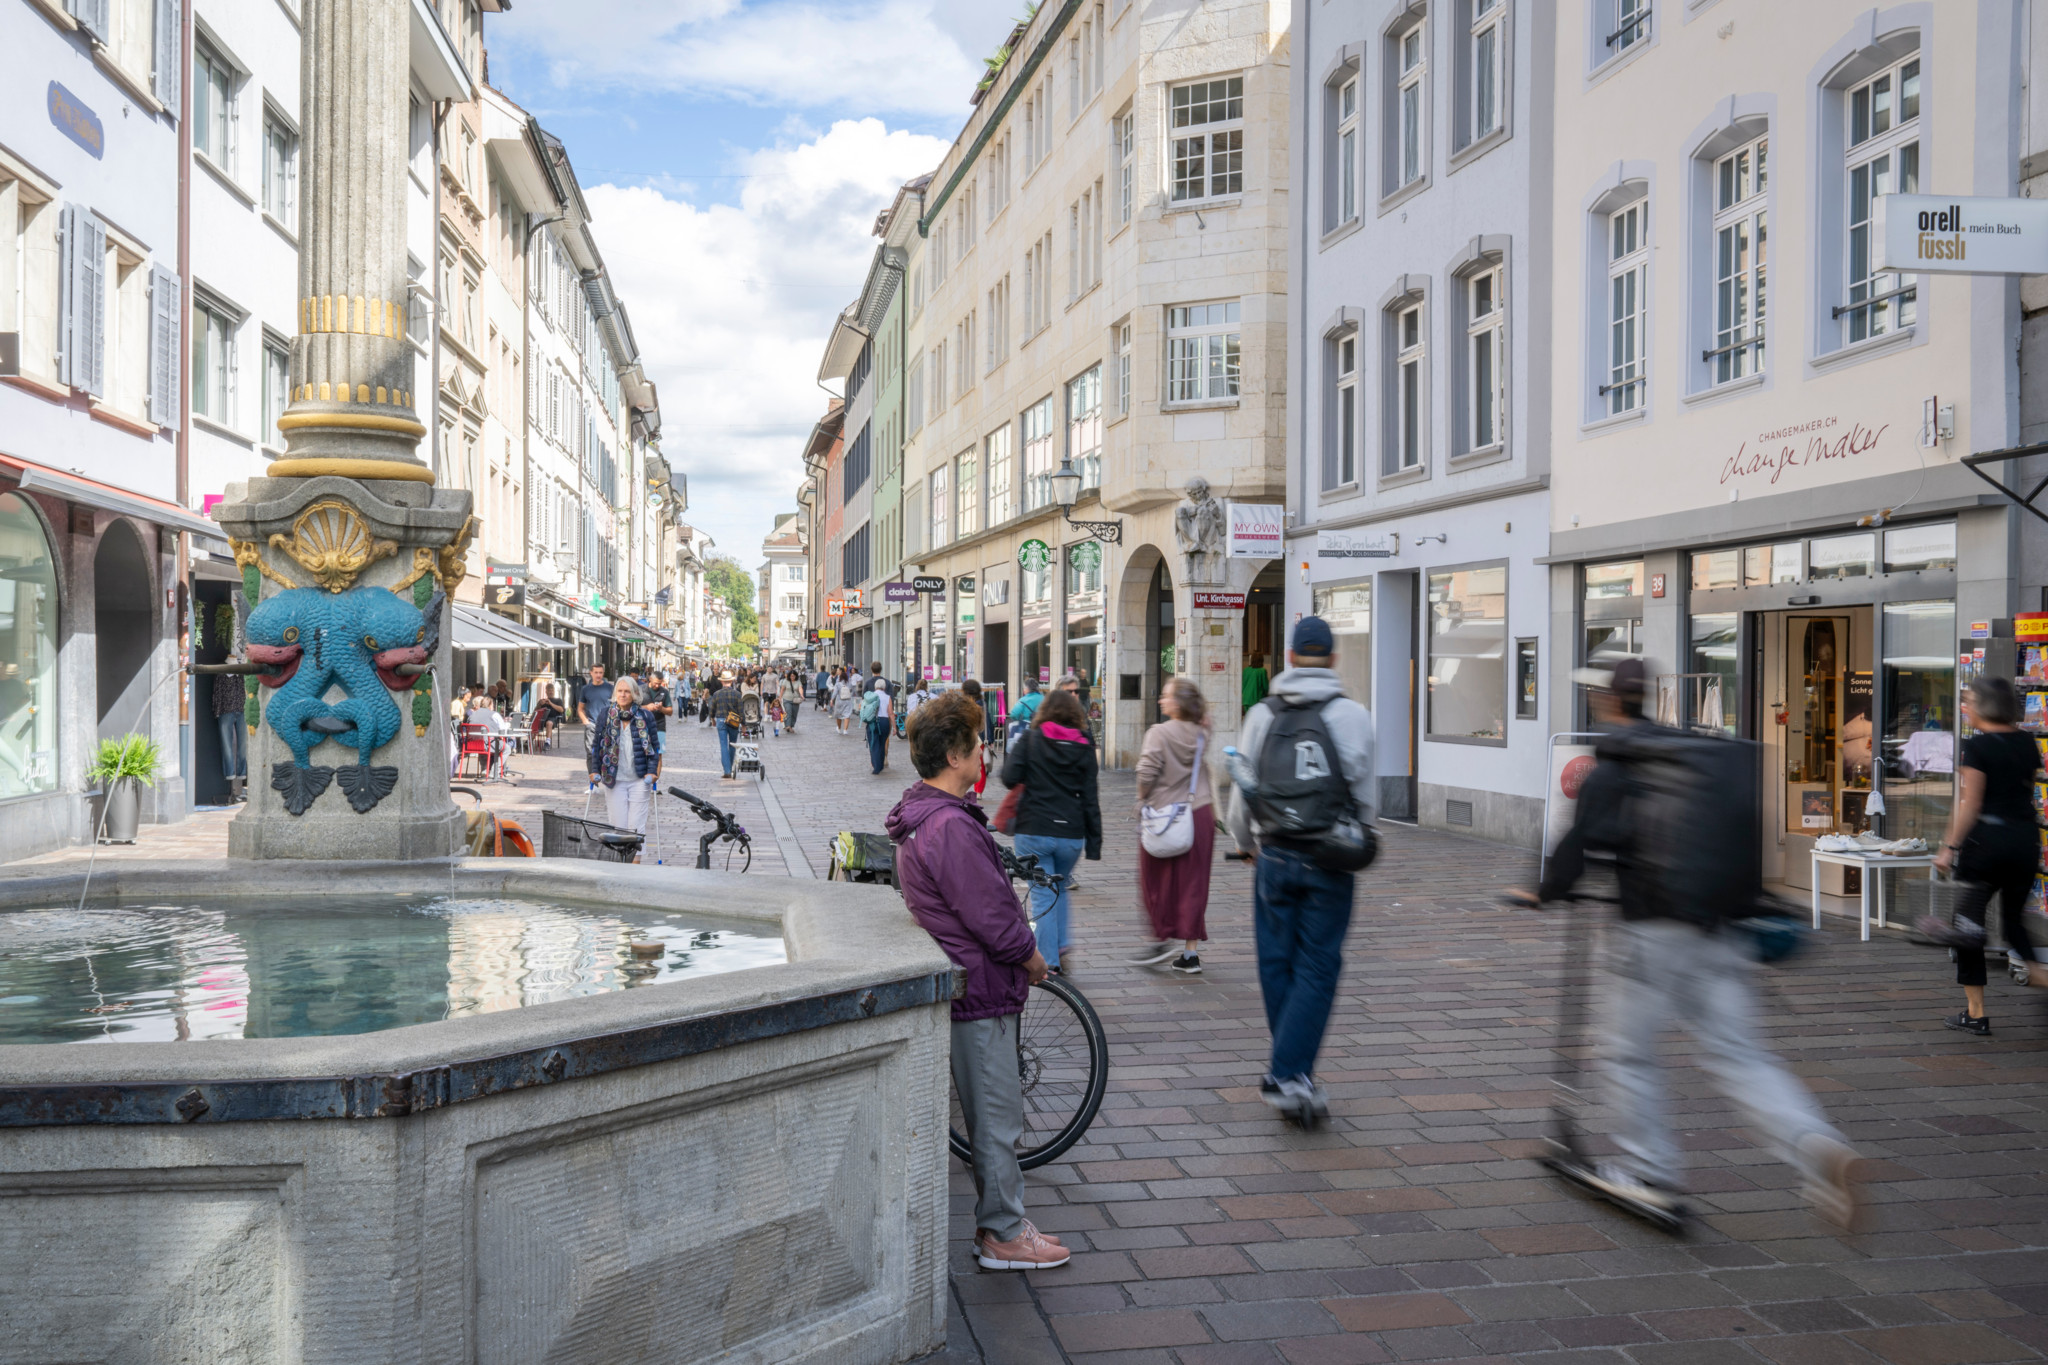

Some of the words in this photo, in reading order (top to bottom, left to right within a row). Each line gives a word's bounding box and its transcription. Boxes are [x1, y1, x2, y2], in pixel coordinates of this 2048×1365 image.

[1969, 224, 1995, 234] mein
[1996, 223, 2021, 235] Buch
[1918, 228, 1966, 260] füssli
[1758, 416, 1838, 443] CHANGEMAKER.CH
[1720, 441, 1799, 485] change
[1234, 523, 1250, 532] MY
[1253, 523, 1279, 533] OWN
[914, 580, 943, 588] ONLY
[1652, 577, 1663, 591] 39
[888, 588, 916, 596] claire's
[983, 580, 1004, 607] ONLY
[1196, 594, 1209, 602] Unt.
[1210, 594, 1243, 605] Kirchgasse
